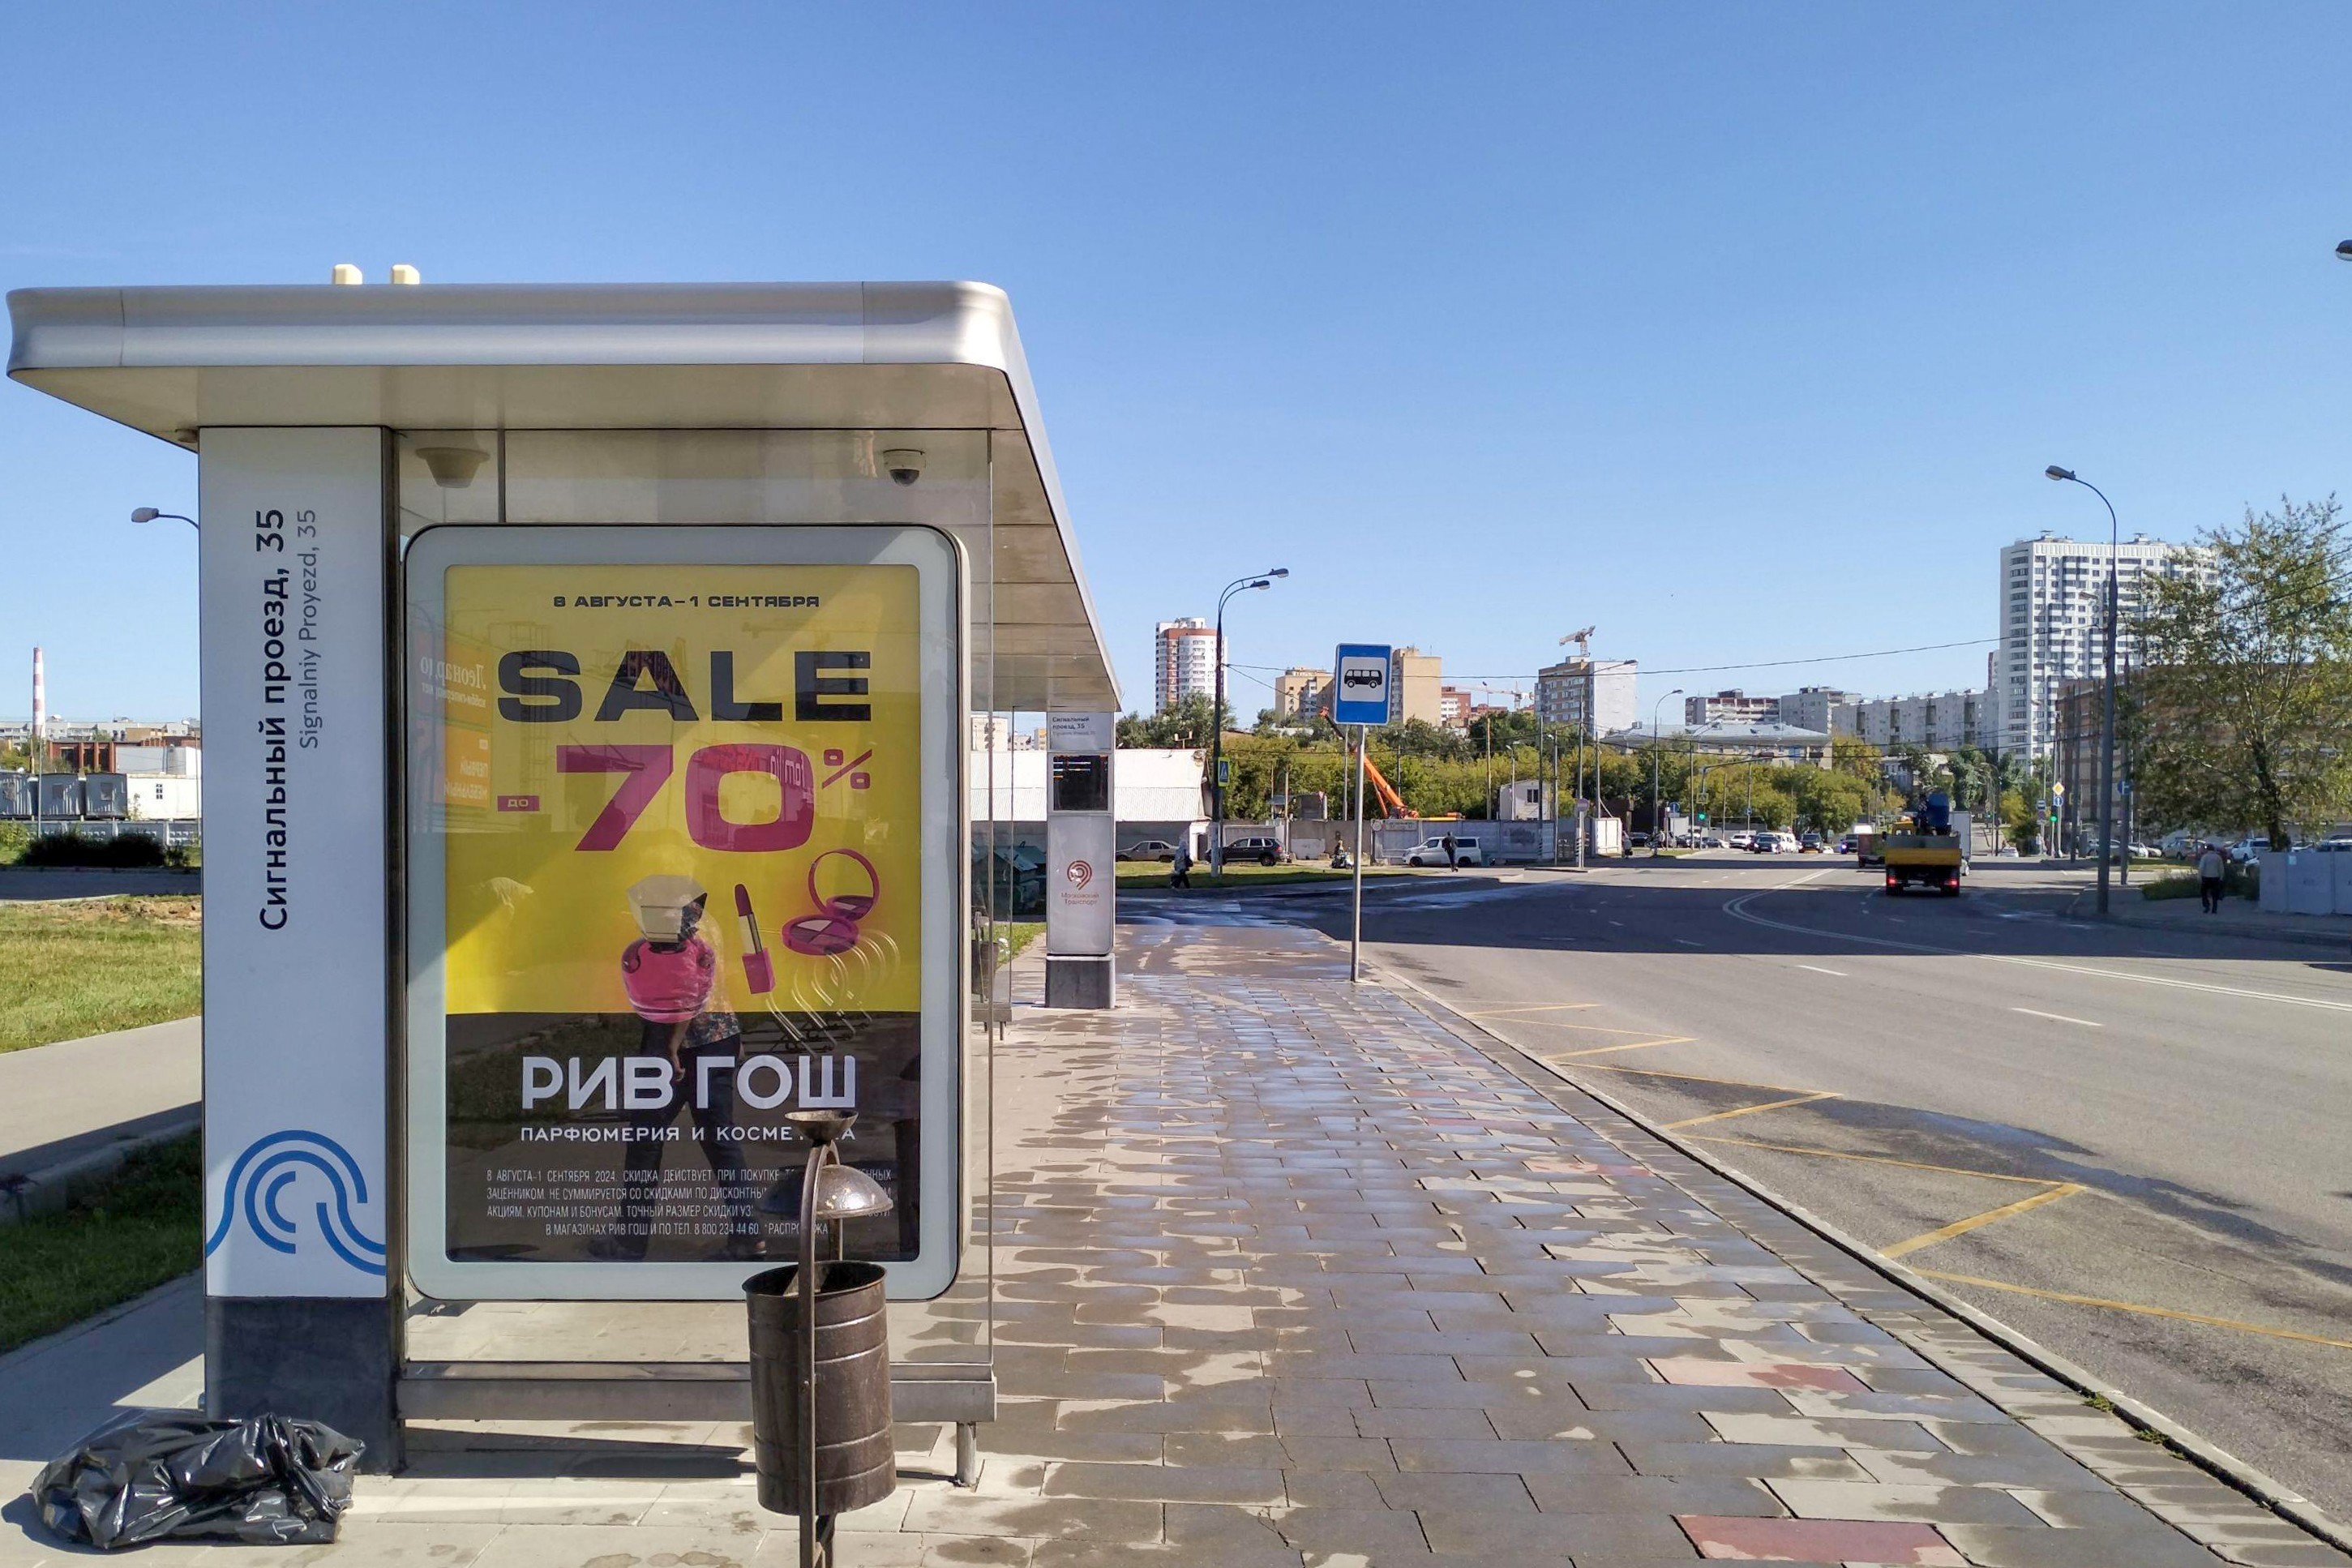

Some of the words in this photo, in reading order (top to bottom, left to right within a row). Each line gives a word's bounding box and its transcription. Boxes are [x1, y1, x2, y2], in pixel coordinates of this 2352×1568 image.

[256, 509, 284, 552] 35
[297, 510, 316, 538] 35
[297, 546, 321, 640] Proyezd,
[553, 596, 566, 607] 8
[708, 596, 820, 607] СЕНТЯБРЯ
[263, 568, 291, 703] проезд,
[298, 649, 322, 748] Signalniy
[497, 650, 872, 722] SALE
[259, 718, 288, 930] Сигнальный
[521, 1056, 675, 1110] РИВ
[696, 1055, 856, 1109] ГОШ
[521, 1126, 679, 1142] ПАРФЮМЕРИЯ
[692, 1126, 705, 1141] И
[717, 1126, 856, 1141] КОСМЕА
[486, 1170, 492, 1181] 8
[547, 1170, 589, 1182] СЕНТЯБРЯ
[623, 1170, 658, 1184] СКИДКА
[663, 1167, 712, 1184] ДЕЙСТВУЕТ
[718, 1169, 735, 1181] ПРИ
[527, 1206, 568, 1218] КУПОНАМ
[571, 1206, 577, 1217] И
[627, 1204, 663, 1217] ТОЧНЫЙ
[666, 1205, 701, 1217] РАЗМЕР
[703, 1205, 739, 1219] СКИДКИ
[549, 1188, 559, 1200] НЕ
[563, 1187, 627, 1200] СУММИРУЕТСЯ
[629, 1188, 641, 1200] СО
[644, 1187, 692, 1201] СКИДКАМИ
[695, 1187, 707, 1199] ПО
[546, 1223, 551, 1236] В
[554, 1223, 606, 1236] МАГАЗИНАХ
[608, 1223, 626, 1236] РИВ
[628, 1223, 648, 1235] ГОШ
[650, 1223, 657, 1235] И
[658, 1223, 671, 1235] ПО
[694, 1223, 700, 1235] 8
[702, 1223, 717, 1235] 800
[719, 1223, 733, 1235] 234
[736, 1223, 746, 1235] 44
